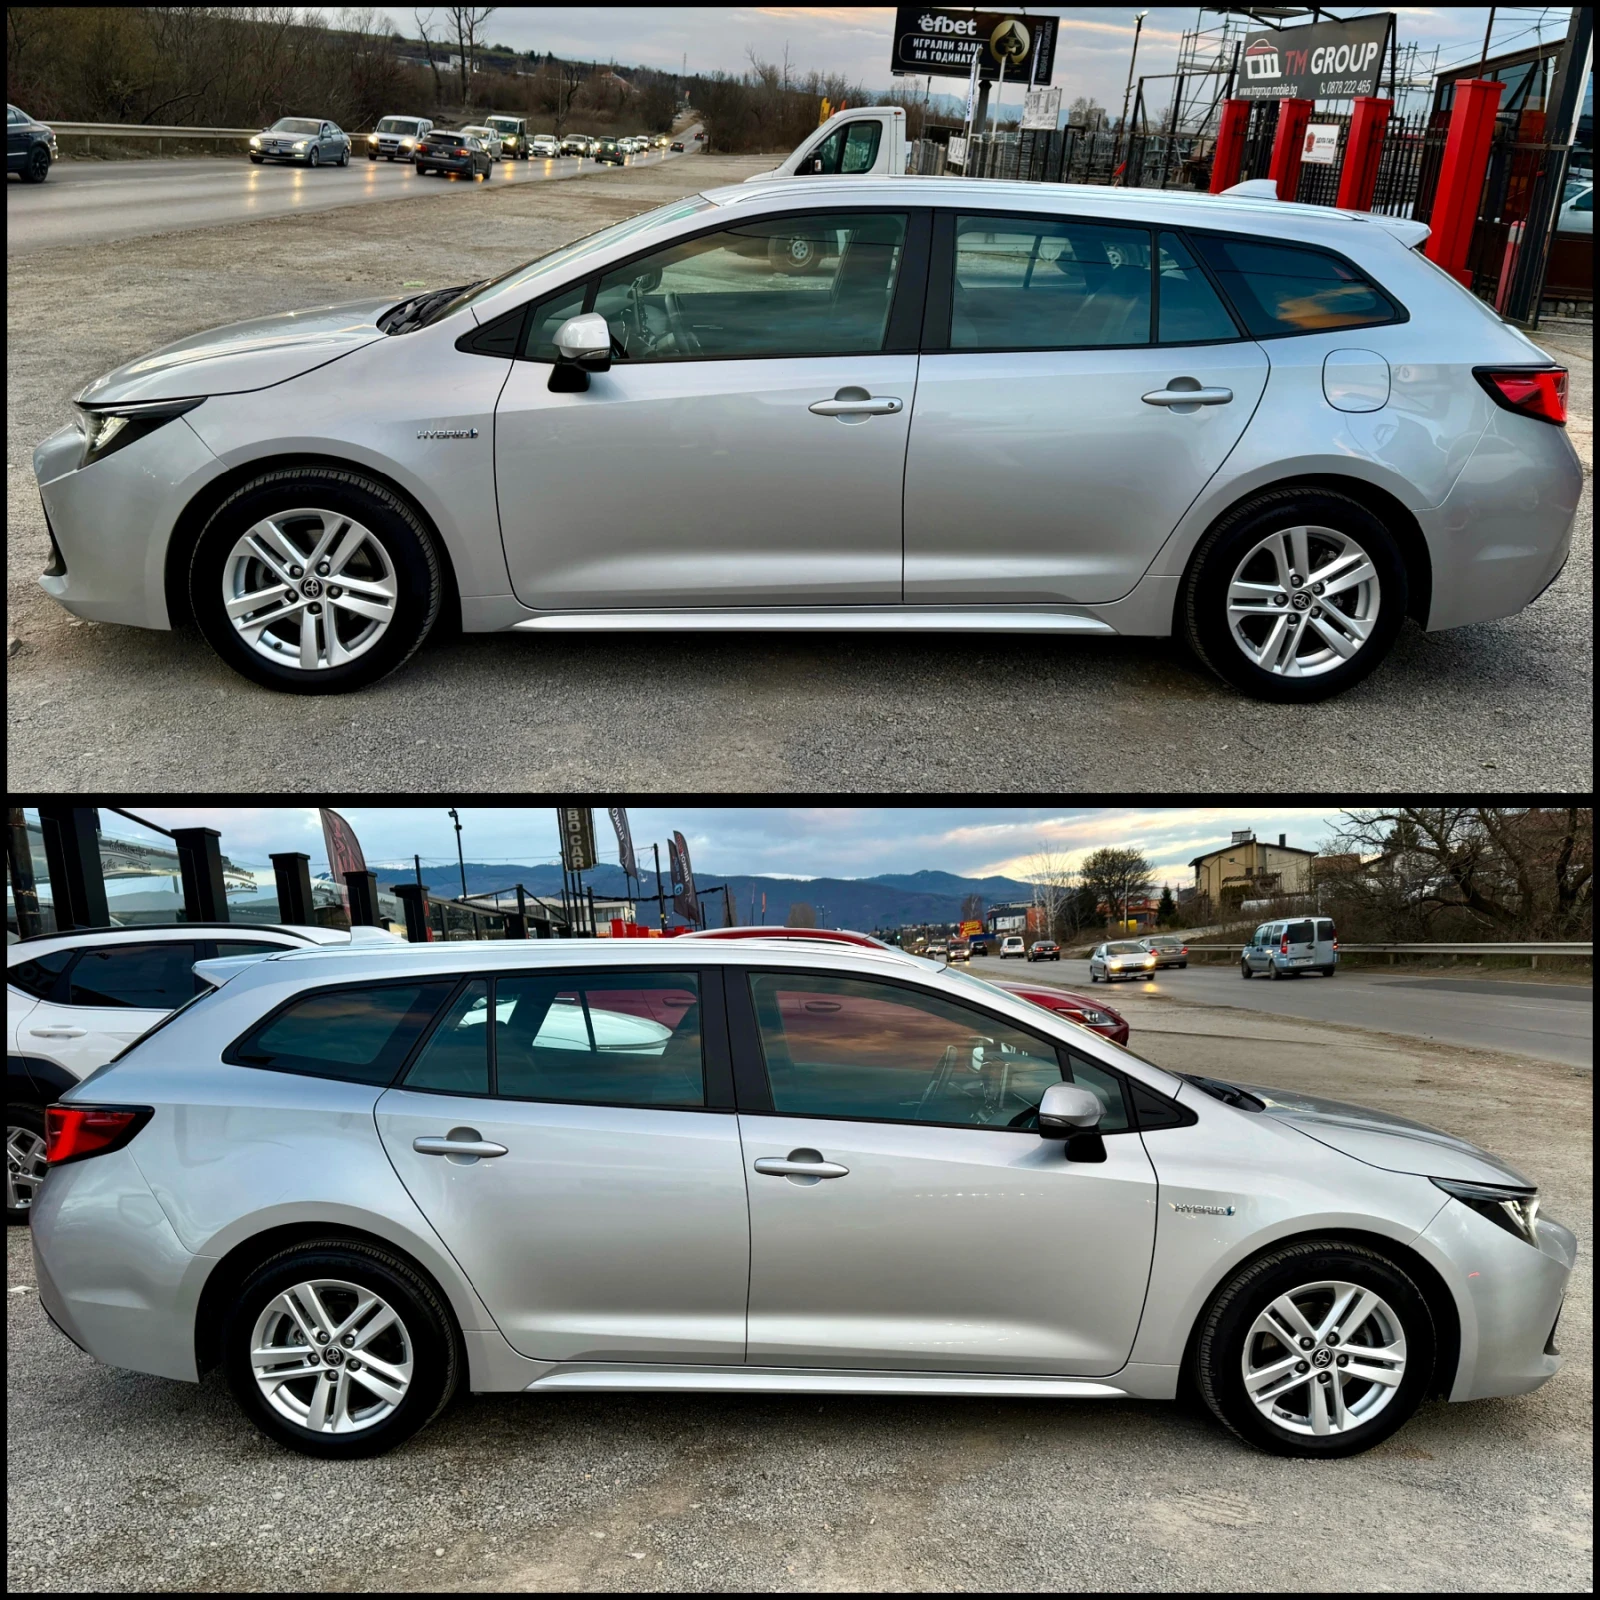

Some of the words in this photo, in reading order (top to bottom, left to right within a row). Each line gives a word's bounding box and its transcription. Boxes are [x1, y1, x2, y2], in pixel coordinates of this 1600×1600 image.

[919, 15, 977, 35] efbet
[912, 37, 955, 51] ИГРАЛНИ
[915, 49, 928, 60] НА
[1285, 50, 1308, 76] TM
[1311, 42, 1378, 75] GROUP
[1326, 81, 1343, 94] 0878
[1343, 80, 1357, 94] 222
[417, 429, 470, 439] HYBRID
[567, 808, 581, 832] BO
[570, 834, 584, 868] CAR
[1174, 1202, 1227, 1216] HYBRID
